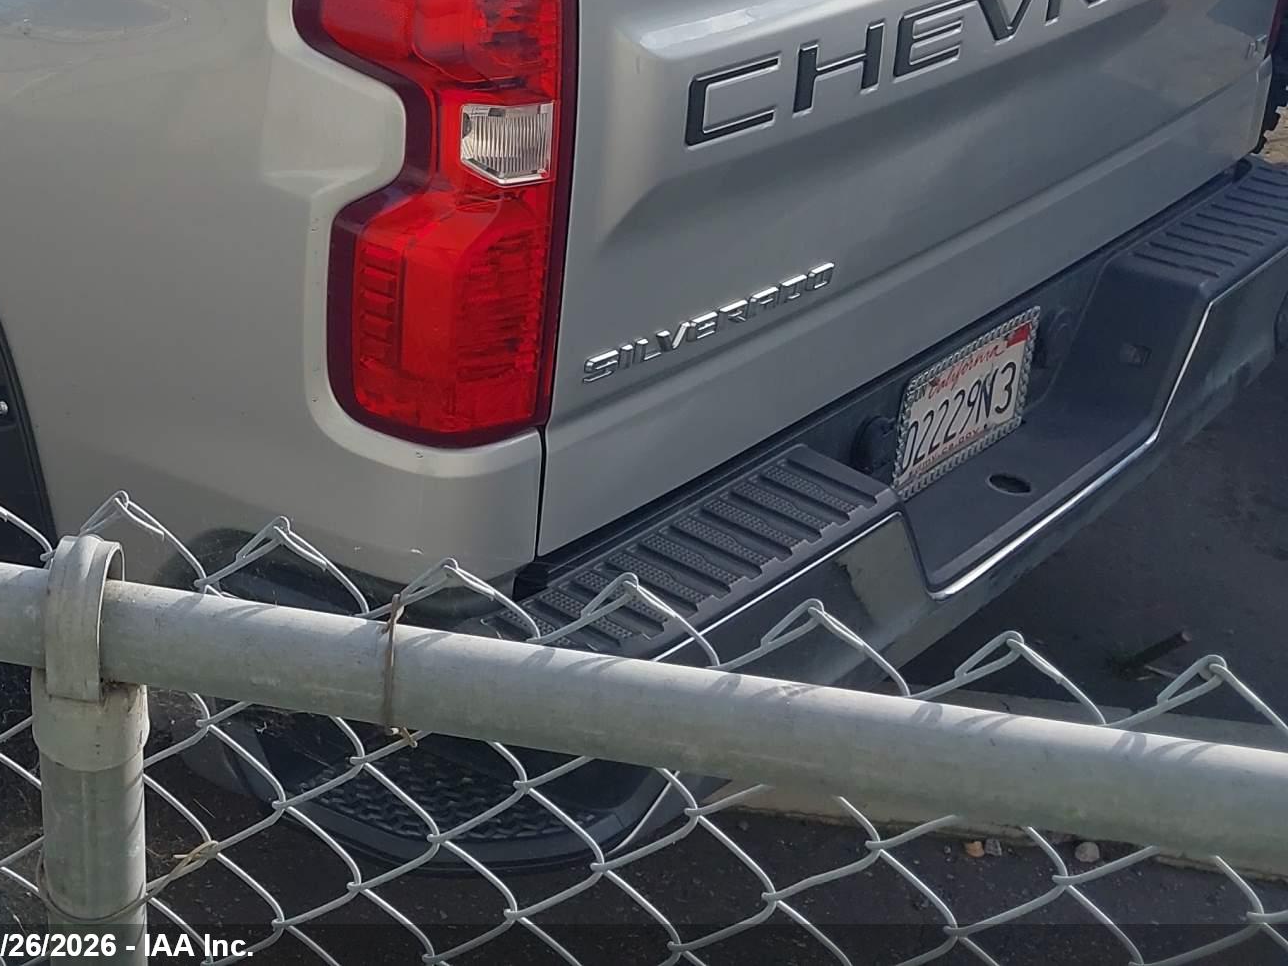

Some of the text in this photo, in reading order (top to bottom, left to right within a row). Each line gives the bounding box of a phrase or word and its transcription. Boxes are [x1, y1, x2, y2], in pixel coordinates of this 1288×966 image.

[582, 261, 836, 383] SILVERADO
[928, 344, 1005, 400] California
[901, 362, 1016, 474] 02229N3
